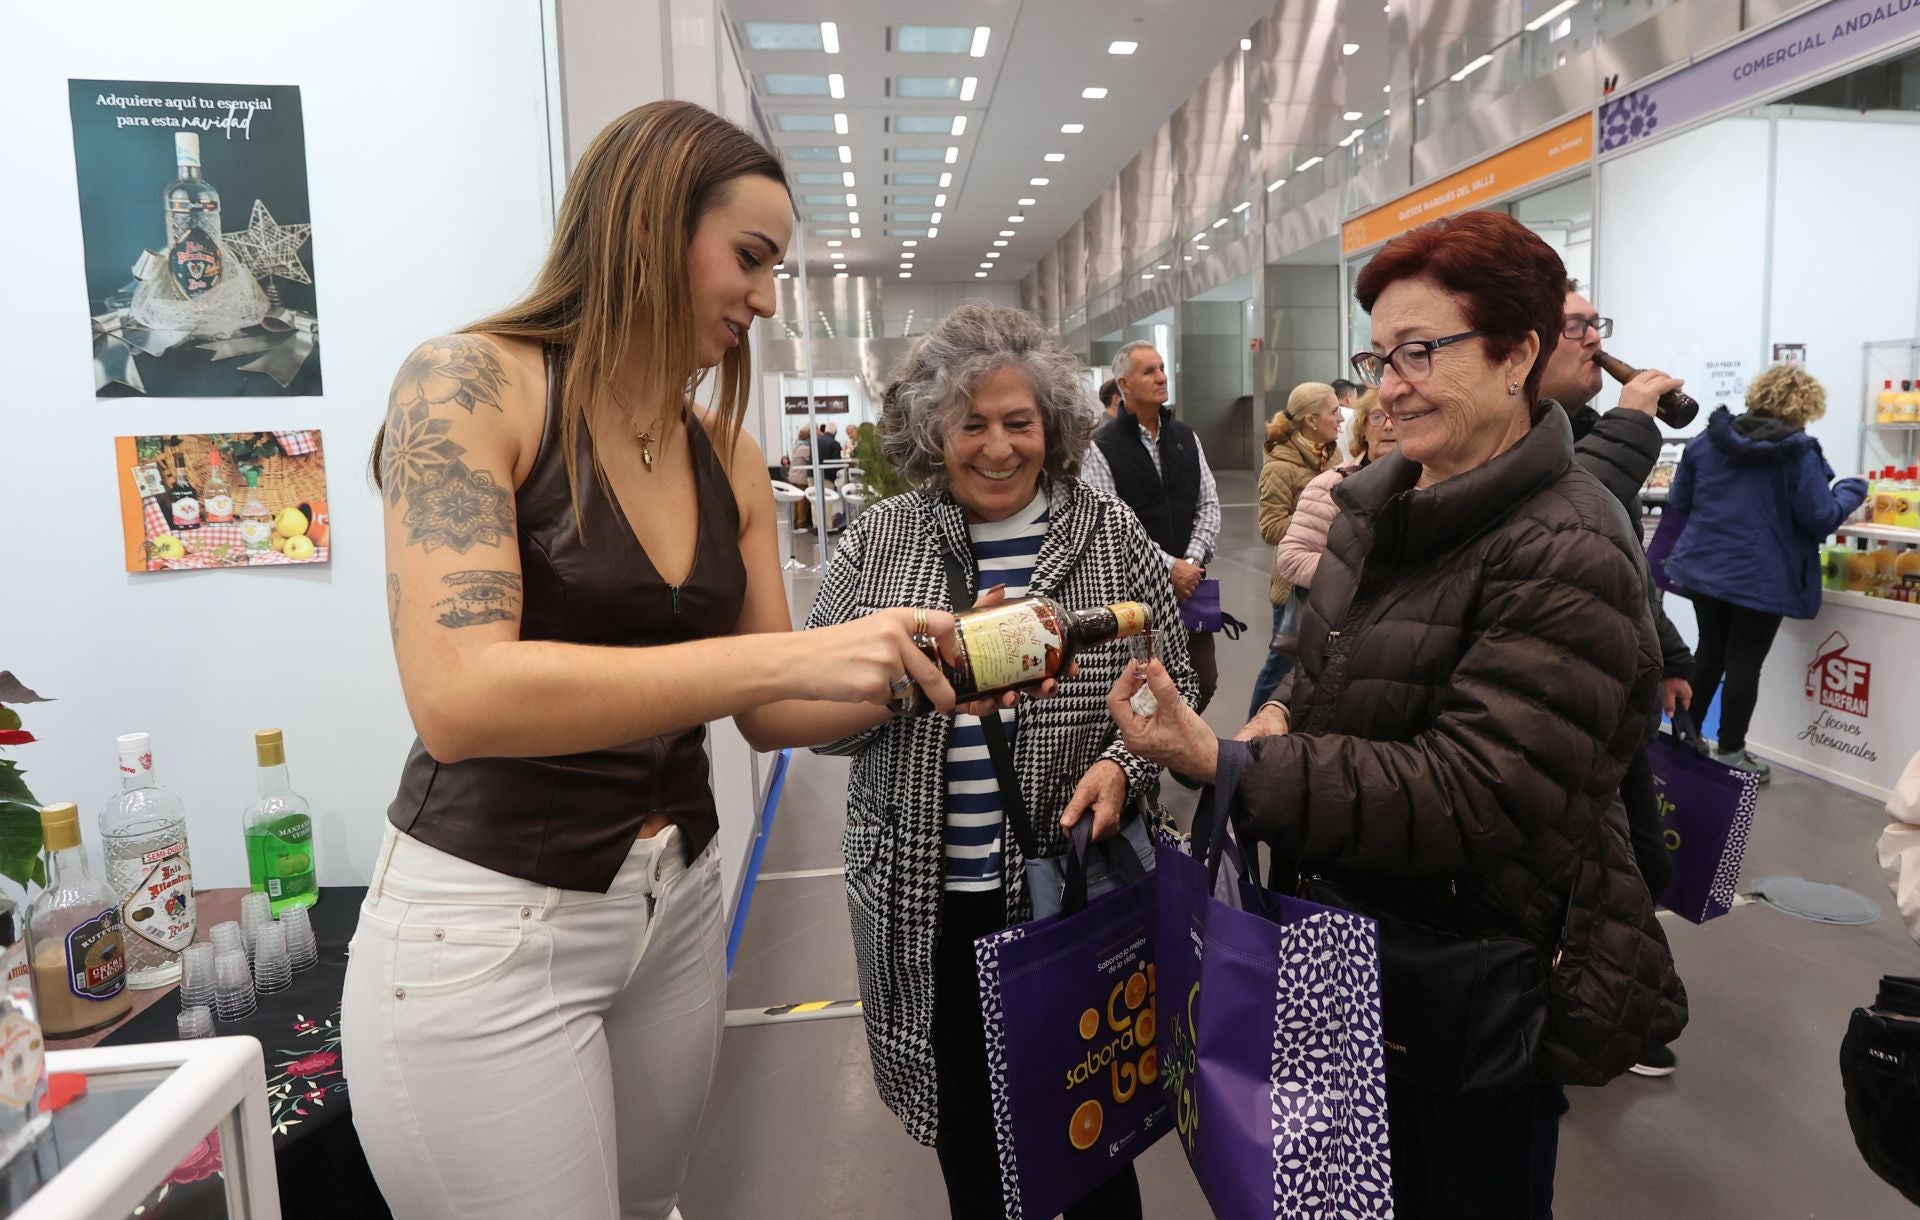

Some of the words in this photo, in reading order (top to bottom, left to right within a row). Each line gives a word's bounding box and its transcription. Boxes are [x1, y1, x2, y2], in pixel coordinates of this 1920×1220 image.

[1733, 33, 1826, 81] COMERCIAL
[96, 94, 163, 110] Adquiere
[164, 96, 198, 111] aquí
[199, 97, 215, 109] tu
[217, 97, 272, 110] esencial
[116, 115, 150, 128] para
[151, 116, 180, 127] esta
[181, 105, 255, 140] navidad
[1399, 204, 1422, 221] QUESOS
[1456, 184, 1471, 199] DEL
[1471, 172, 1496, 191] VALLE
[1825, 657, 1867, 694] SF
[1822, 689, 1867, 715] SARFRAN
[1813, 709, 1861, 736] Licores
[1797, 724, 1877, 762] Artesanales
[147, 842, 185, 861] SEMI-DULCE
[92, 955, 124, 976] CREMA
[1097, 951, 1123, 972] Saborea
[1129, 937, 1147, 953] mejor
[1108, 964, 1117, 974] de
[1117, 961, 1123, 969] la
[1123, 953, 1137, 965] vida
[100, 961, 124, 980] LICOR
